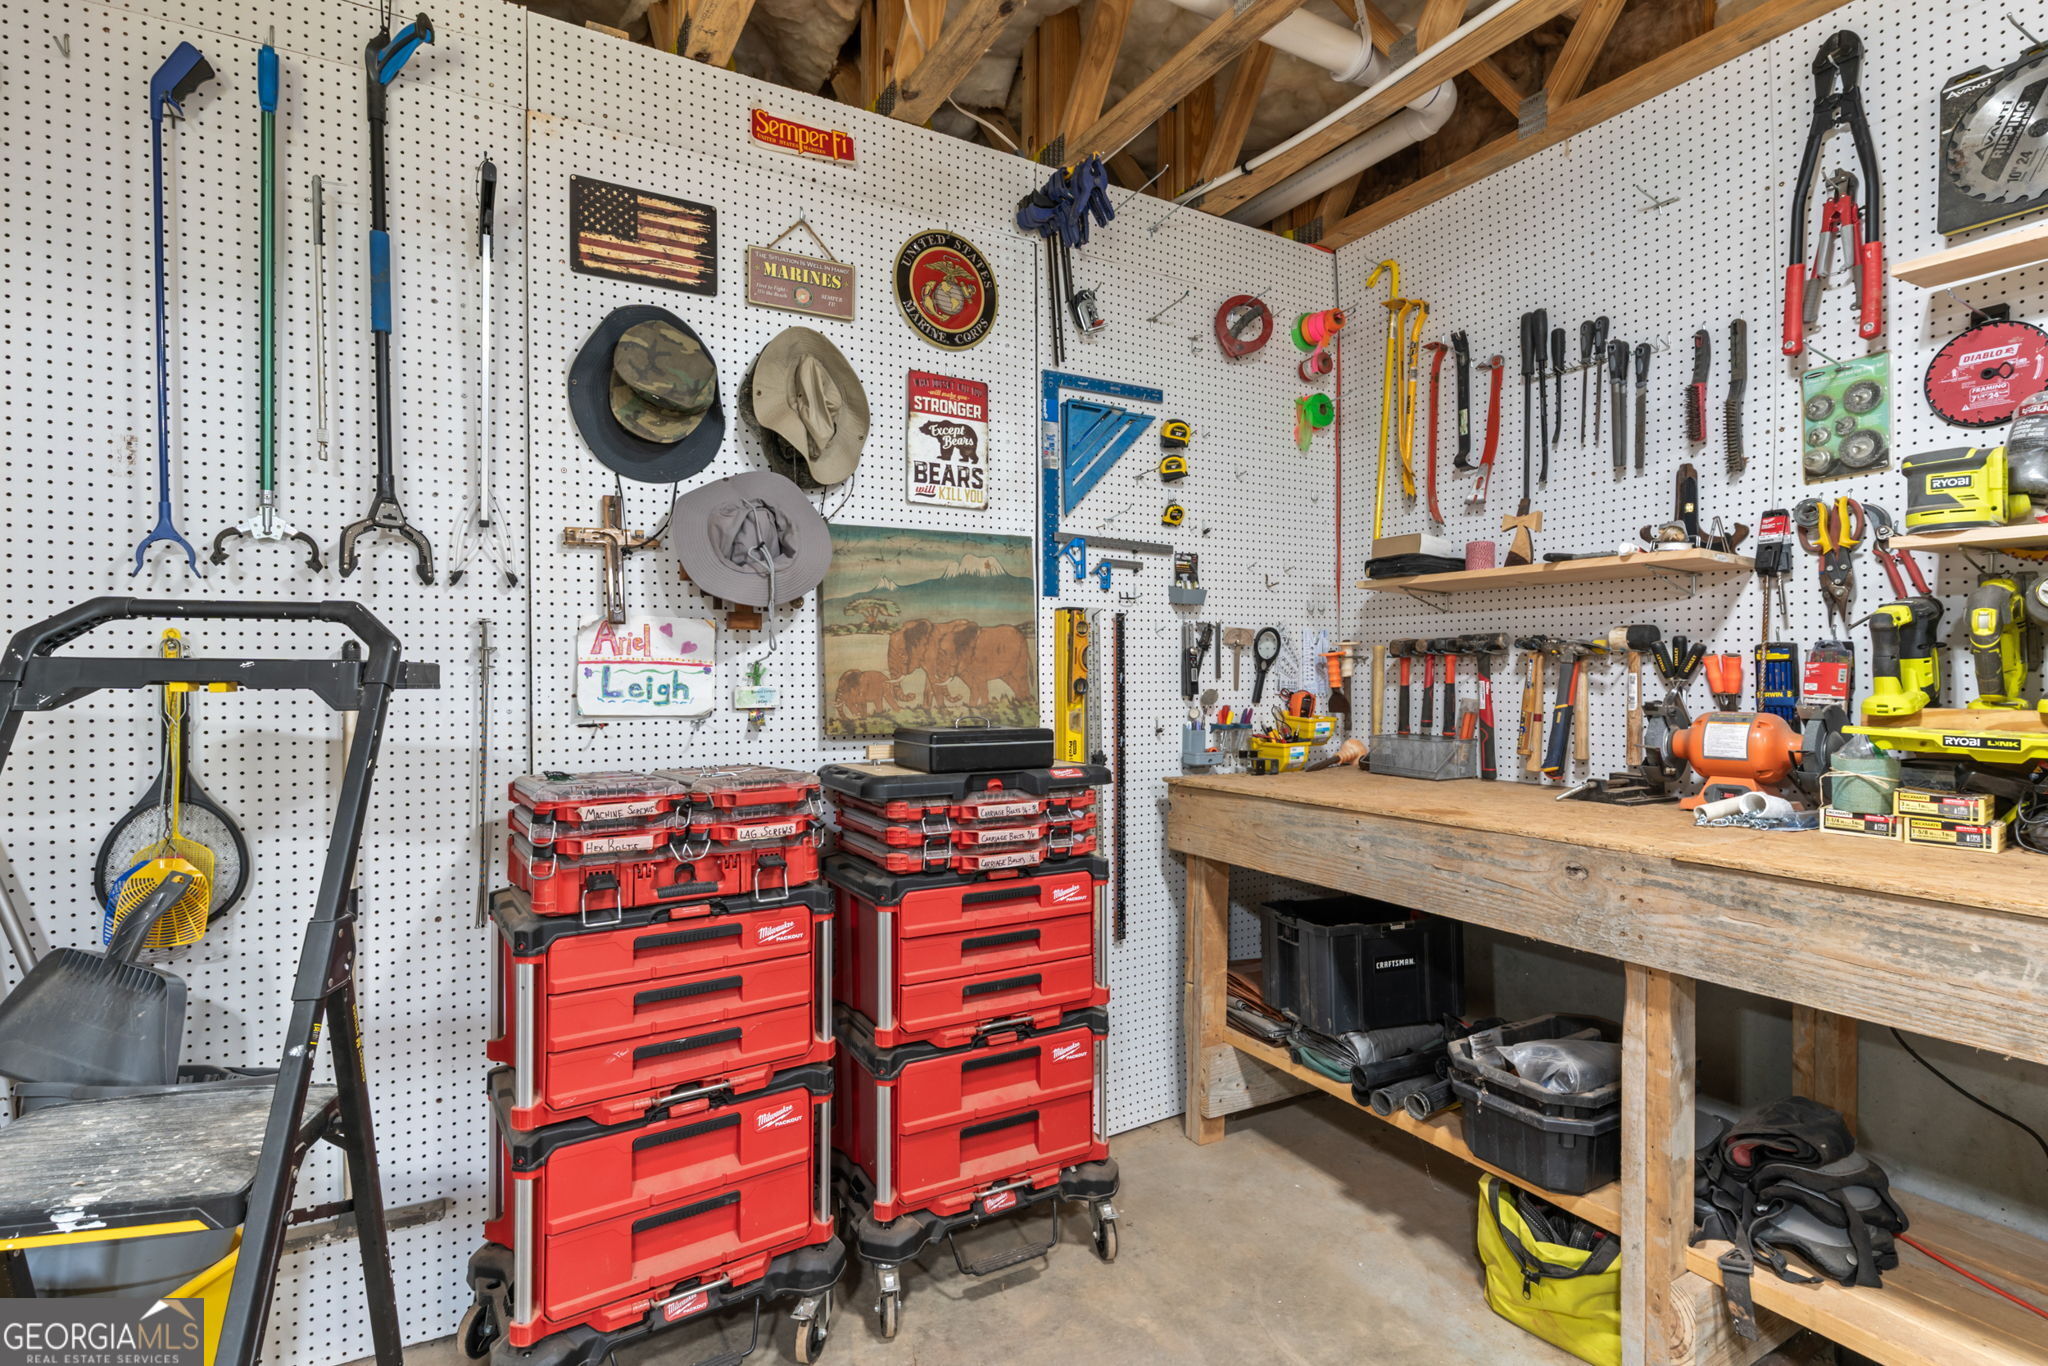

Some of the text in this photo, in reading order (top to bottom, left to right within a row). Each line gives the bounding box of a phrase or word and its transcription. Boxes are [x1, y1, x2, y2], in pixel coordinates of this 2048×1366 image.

[756, 108, 848, 160] Semper Fi
[1991, 100, 2031, 159] RIPPING
[757, 132, 777, 143] UNITED
[779, 139, 800, 149] STATES
[2019, 150, 2033, 165] 24
[901, 234, 993, 289] UNITED STATES
[763, 261, 843, 290] MARINES
[903, 299, 989, 345] MARINE CORPS
[1963, 349, 2004, 363] DIABLO
[1971, 383, 2007, 394] FRAMING
[914, 395, 982, 419] STRONGER
[928, 424, 965, 438] Except
[942, 434, 974, 449] Bears
[913, 460, 984, 489] BEARS
[1932, 477, 1970, 488] RYOBI
[915, 485, 983, 503] will KILL YOU
[590, 620, 651, 657] Ariel
[1683, 654, 1697, 673] STANLEY
[601, 665, 690, 707] Leigh
[1944, 736, 1981, 747] RYOBI
[585, 808, 624, 821] MACHINE
[739, 825, 794, 840] LAG SCREWS
[586, 841, 606, 852] HEX
[1053, 885, 1080, 900] Milwaukee
[757, 921, 795, 940] Milwaukee
[776, 932, 804, 942] PACKOUT
[1376, 958, 1414, 969] CRAFTSMAN
[1052, 1042, 1081, 1059] Milwaukee
[757, 1104, 793, 1127] Milwaukee
[775, 1115, 803, 1127] PACKOUT
[667, 1293, 697, 1315] Milwaukee
